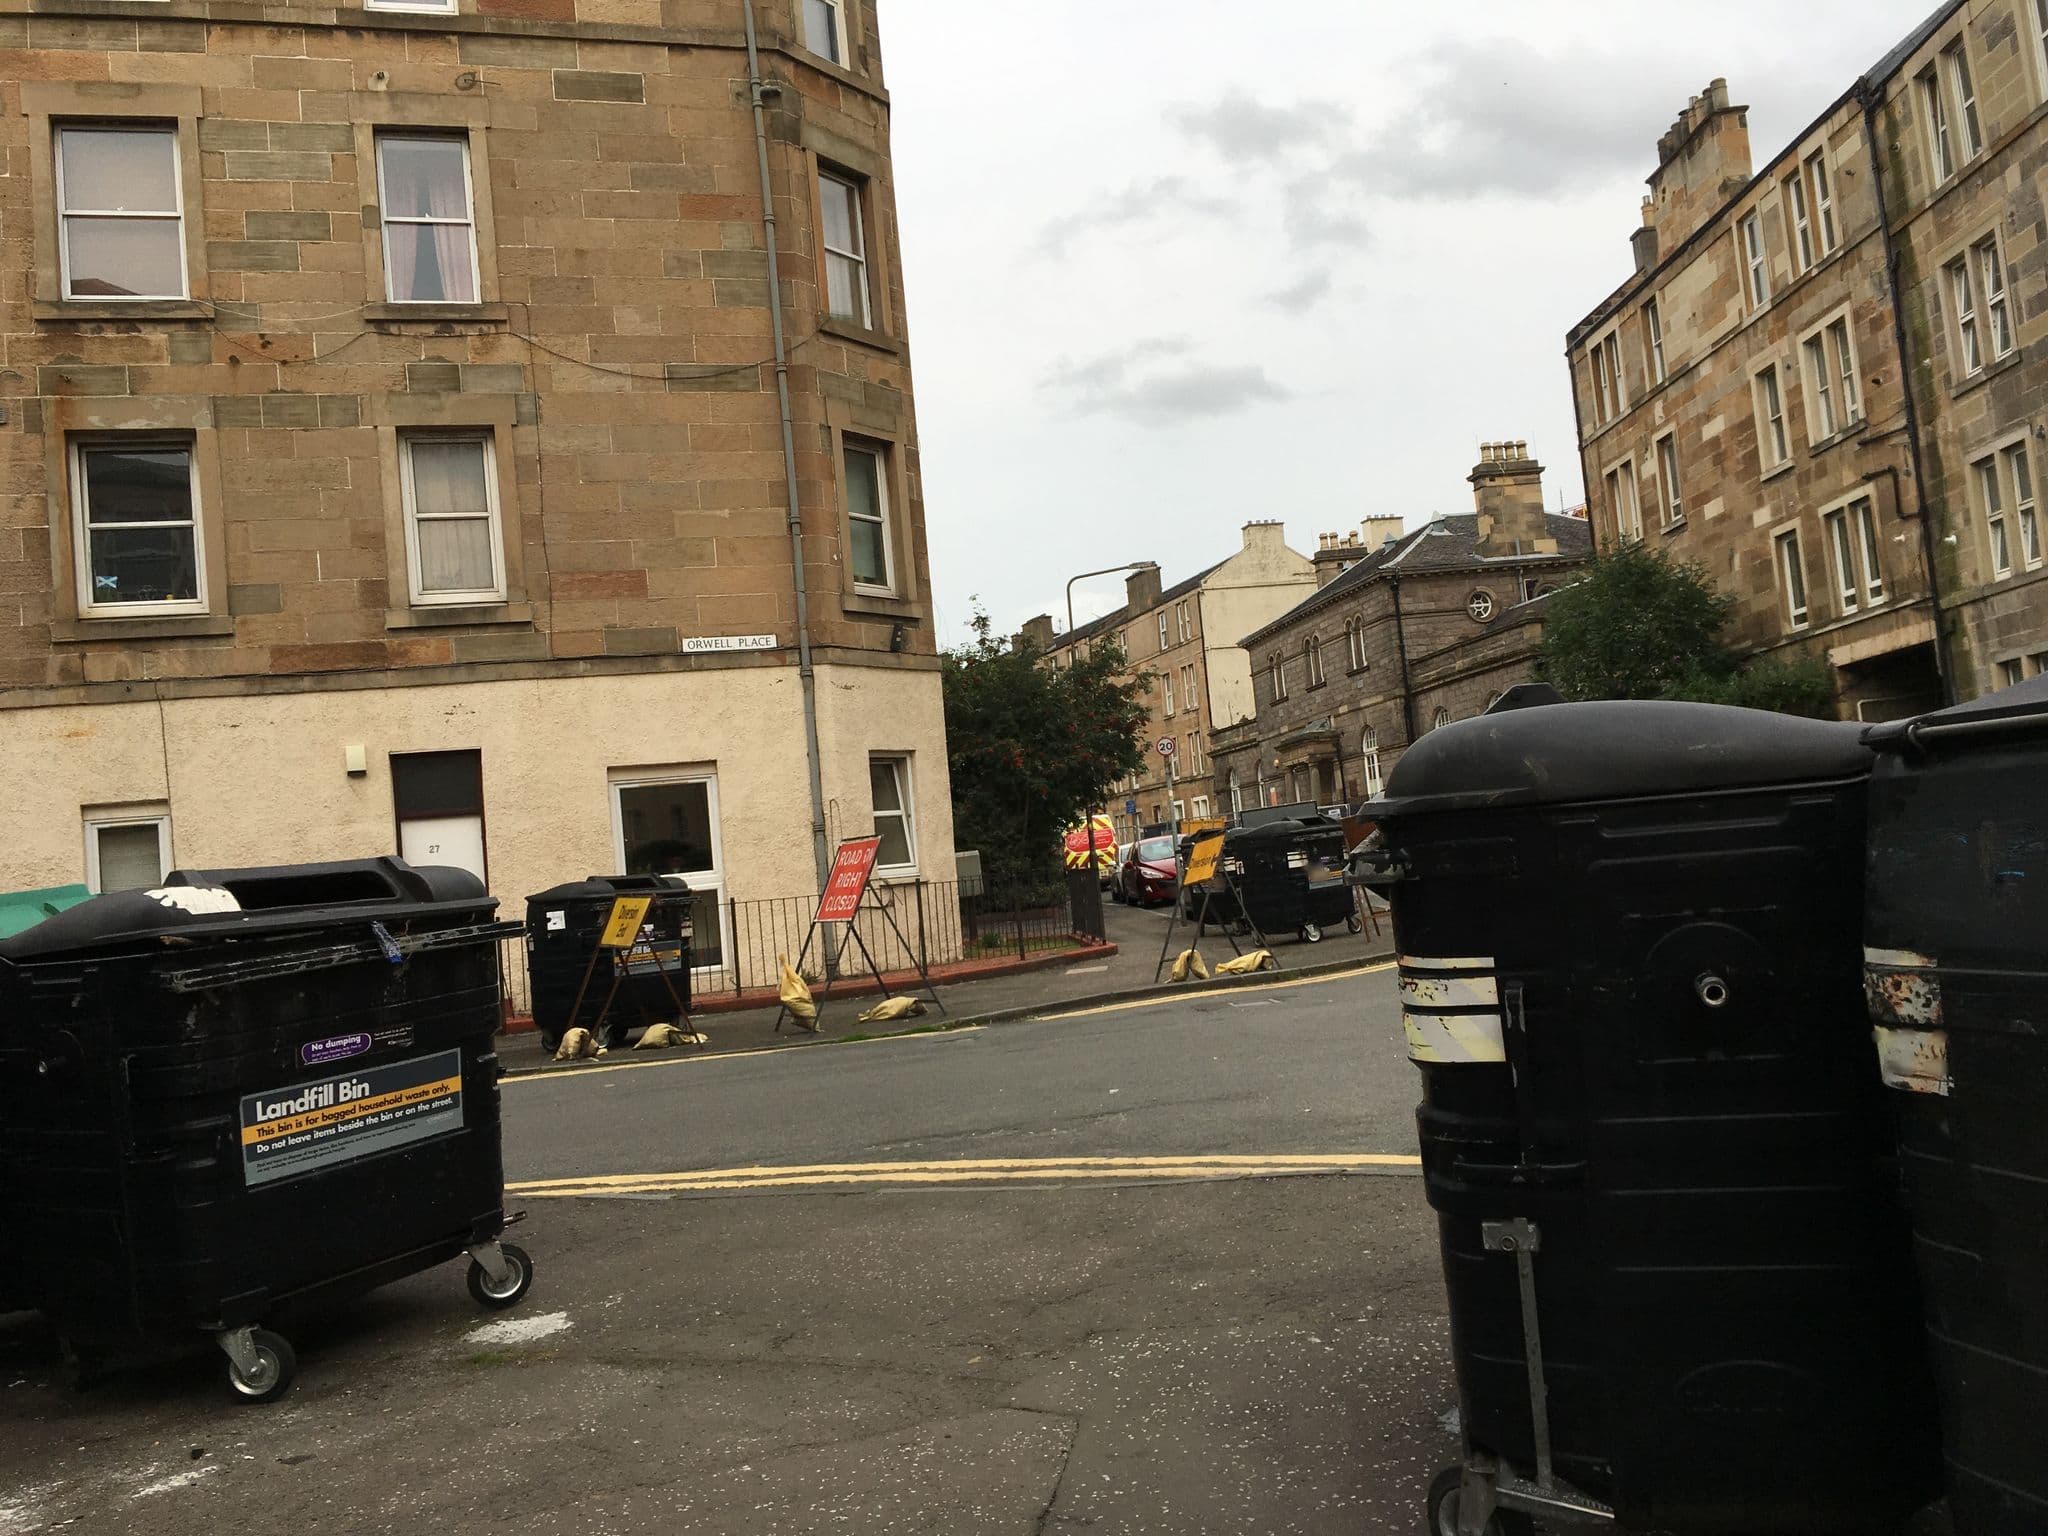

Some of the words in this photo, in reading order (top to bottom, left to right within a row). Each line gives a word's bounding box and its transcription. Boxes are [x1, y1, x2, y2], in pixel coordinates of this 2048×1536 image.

[687, 639, 732, 649] ORWELL
[738, 637, 771, 647] PLACE
[1159, 742, 1173, 752] 20
[429, 845, 440, 853] 27
[838, 848, 863, 867] ROAD
[836, 871, 863, 889] RIGHT
[825, 894, 857, 912] CLOSED
[311, 1043, 324, 1052] No
[325, 1034, 361, 1049] dumping
[256, 1083, 334, 1122] Landfill
[339, 1078, 370, 1103] Bin
[256, 1125, 275, 1138] This
[277, 1121, 293, 1133] bin
[295, 1119, 303, 1129] is
[305, 1115, 320, 1126] for
[321, 1105, 356, 1121] bagged
[359, 1093, 403, 1112] household
[405, 1088, 430, 1101] waste
[431, 1083, 451, 1096] only.
[256, 1144, 270, 1154] Do
[271, 1139, 286, 1150] not
[288, 1134, 312, 1146] leave
[313, 1127, 337, 1139] items
[337, 1117, 365, 1133] beside
[366, 1114, 379, 1125] the
[380, 1111, 394, 1122] bin
[394, 1109, 405, 1118] or
[405, 1106, 416, 1115] on
[417, 1102, 431, 1112] the
[431, 1096, 454, 1109] street.
